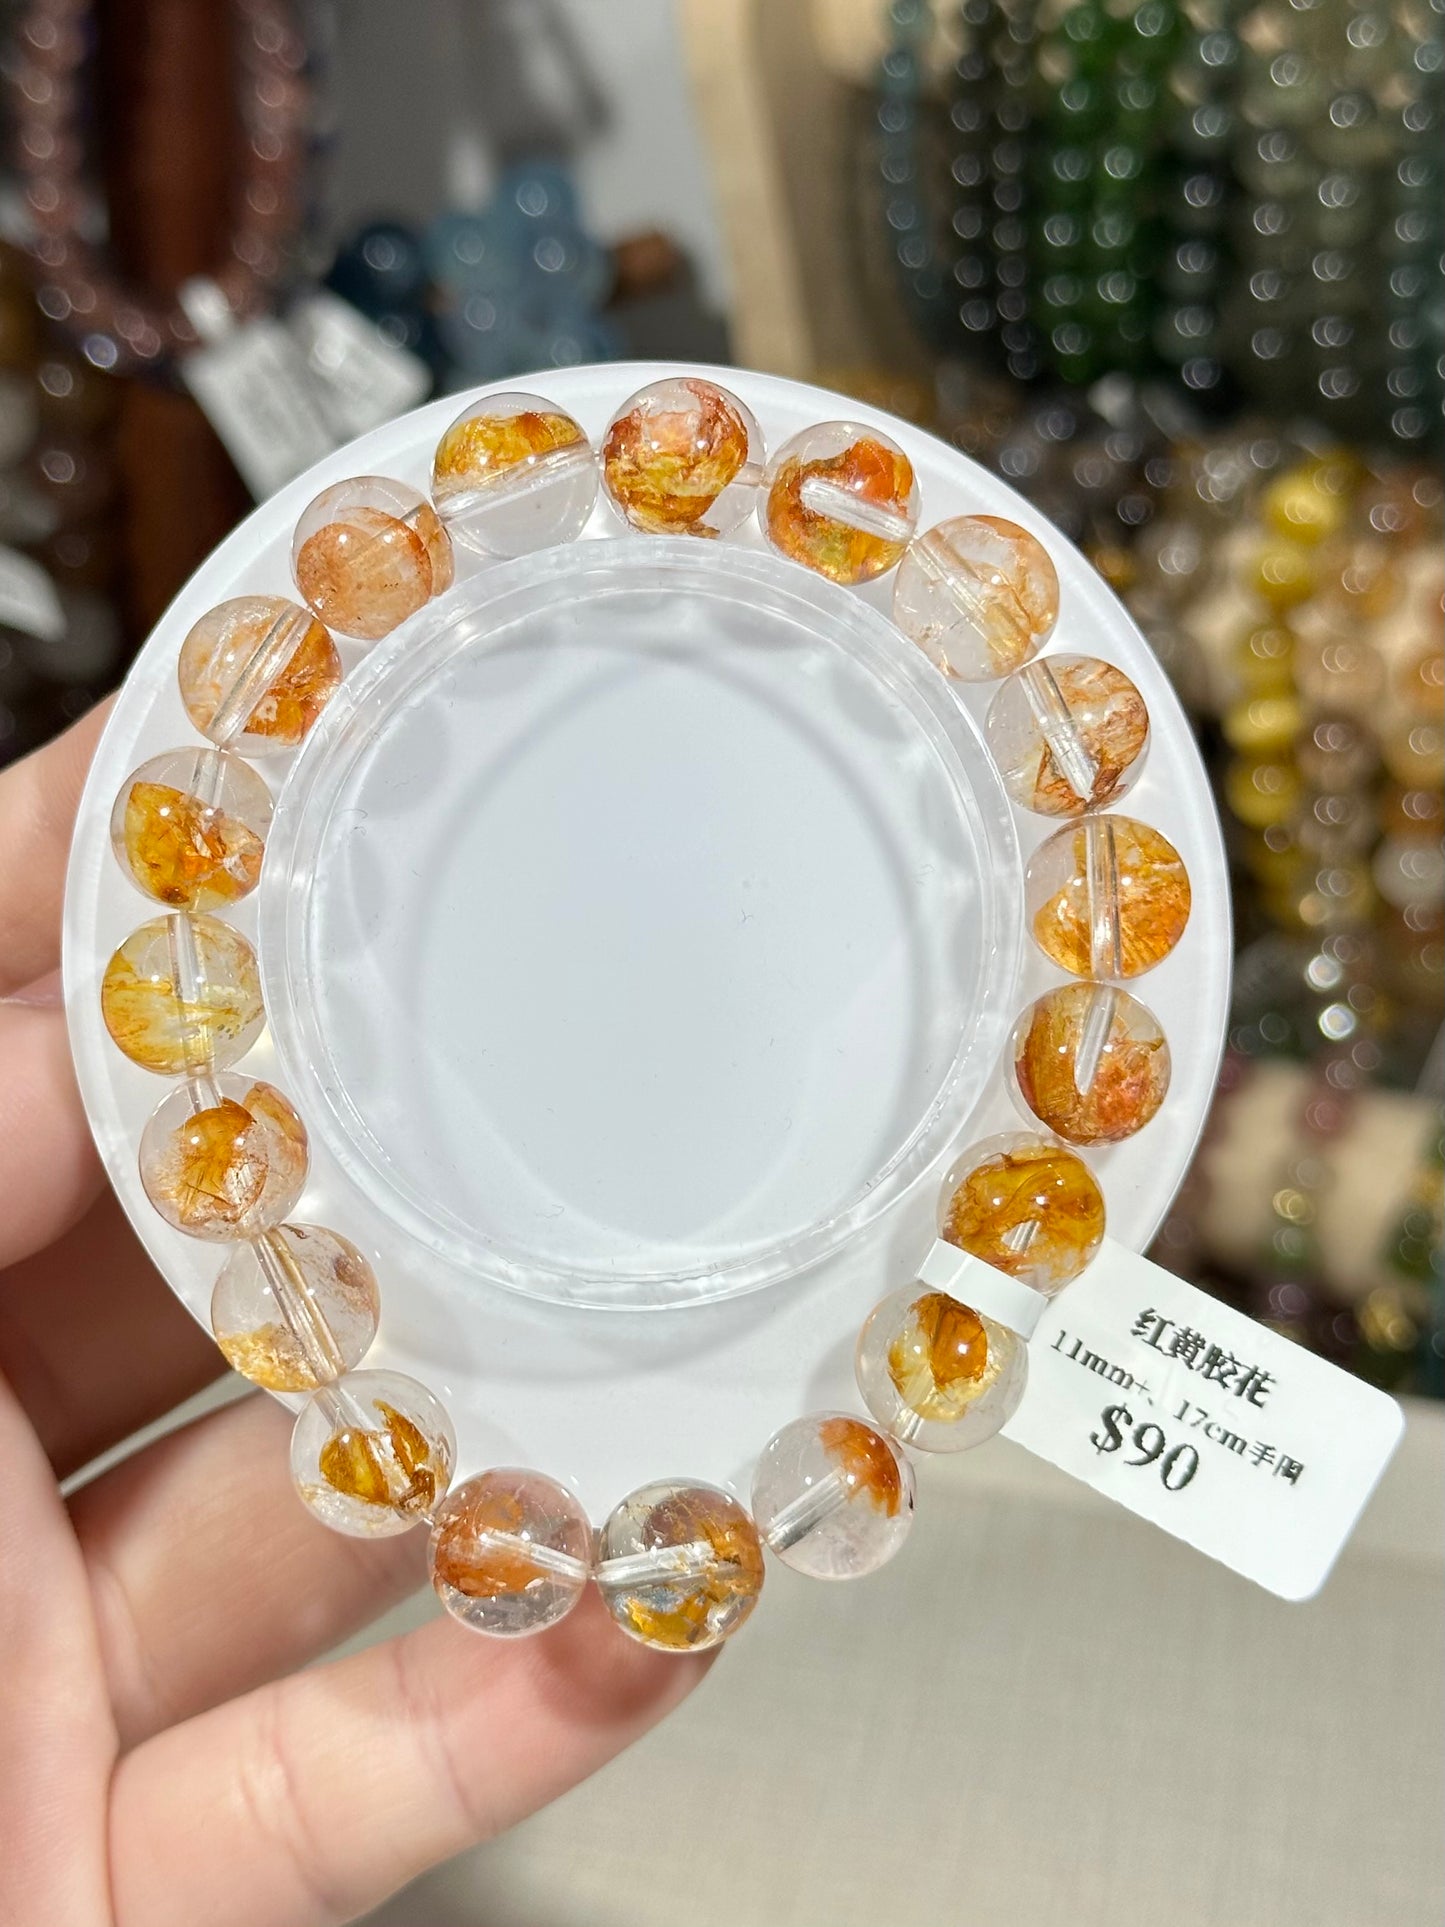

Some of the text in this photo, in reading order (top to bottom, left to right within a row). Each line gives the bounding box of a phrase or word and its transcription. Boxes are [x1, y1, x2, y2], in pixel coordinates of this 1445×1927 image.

[1130, 1307, 1277, 1409] 红黄胶花
[1089, 1402, 1199, 1492] $90
